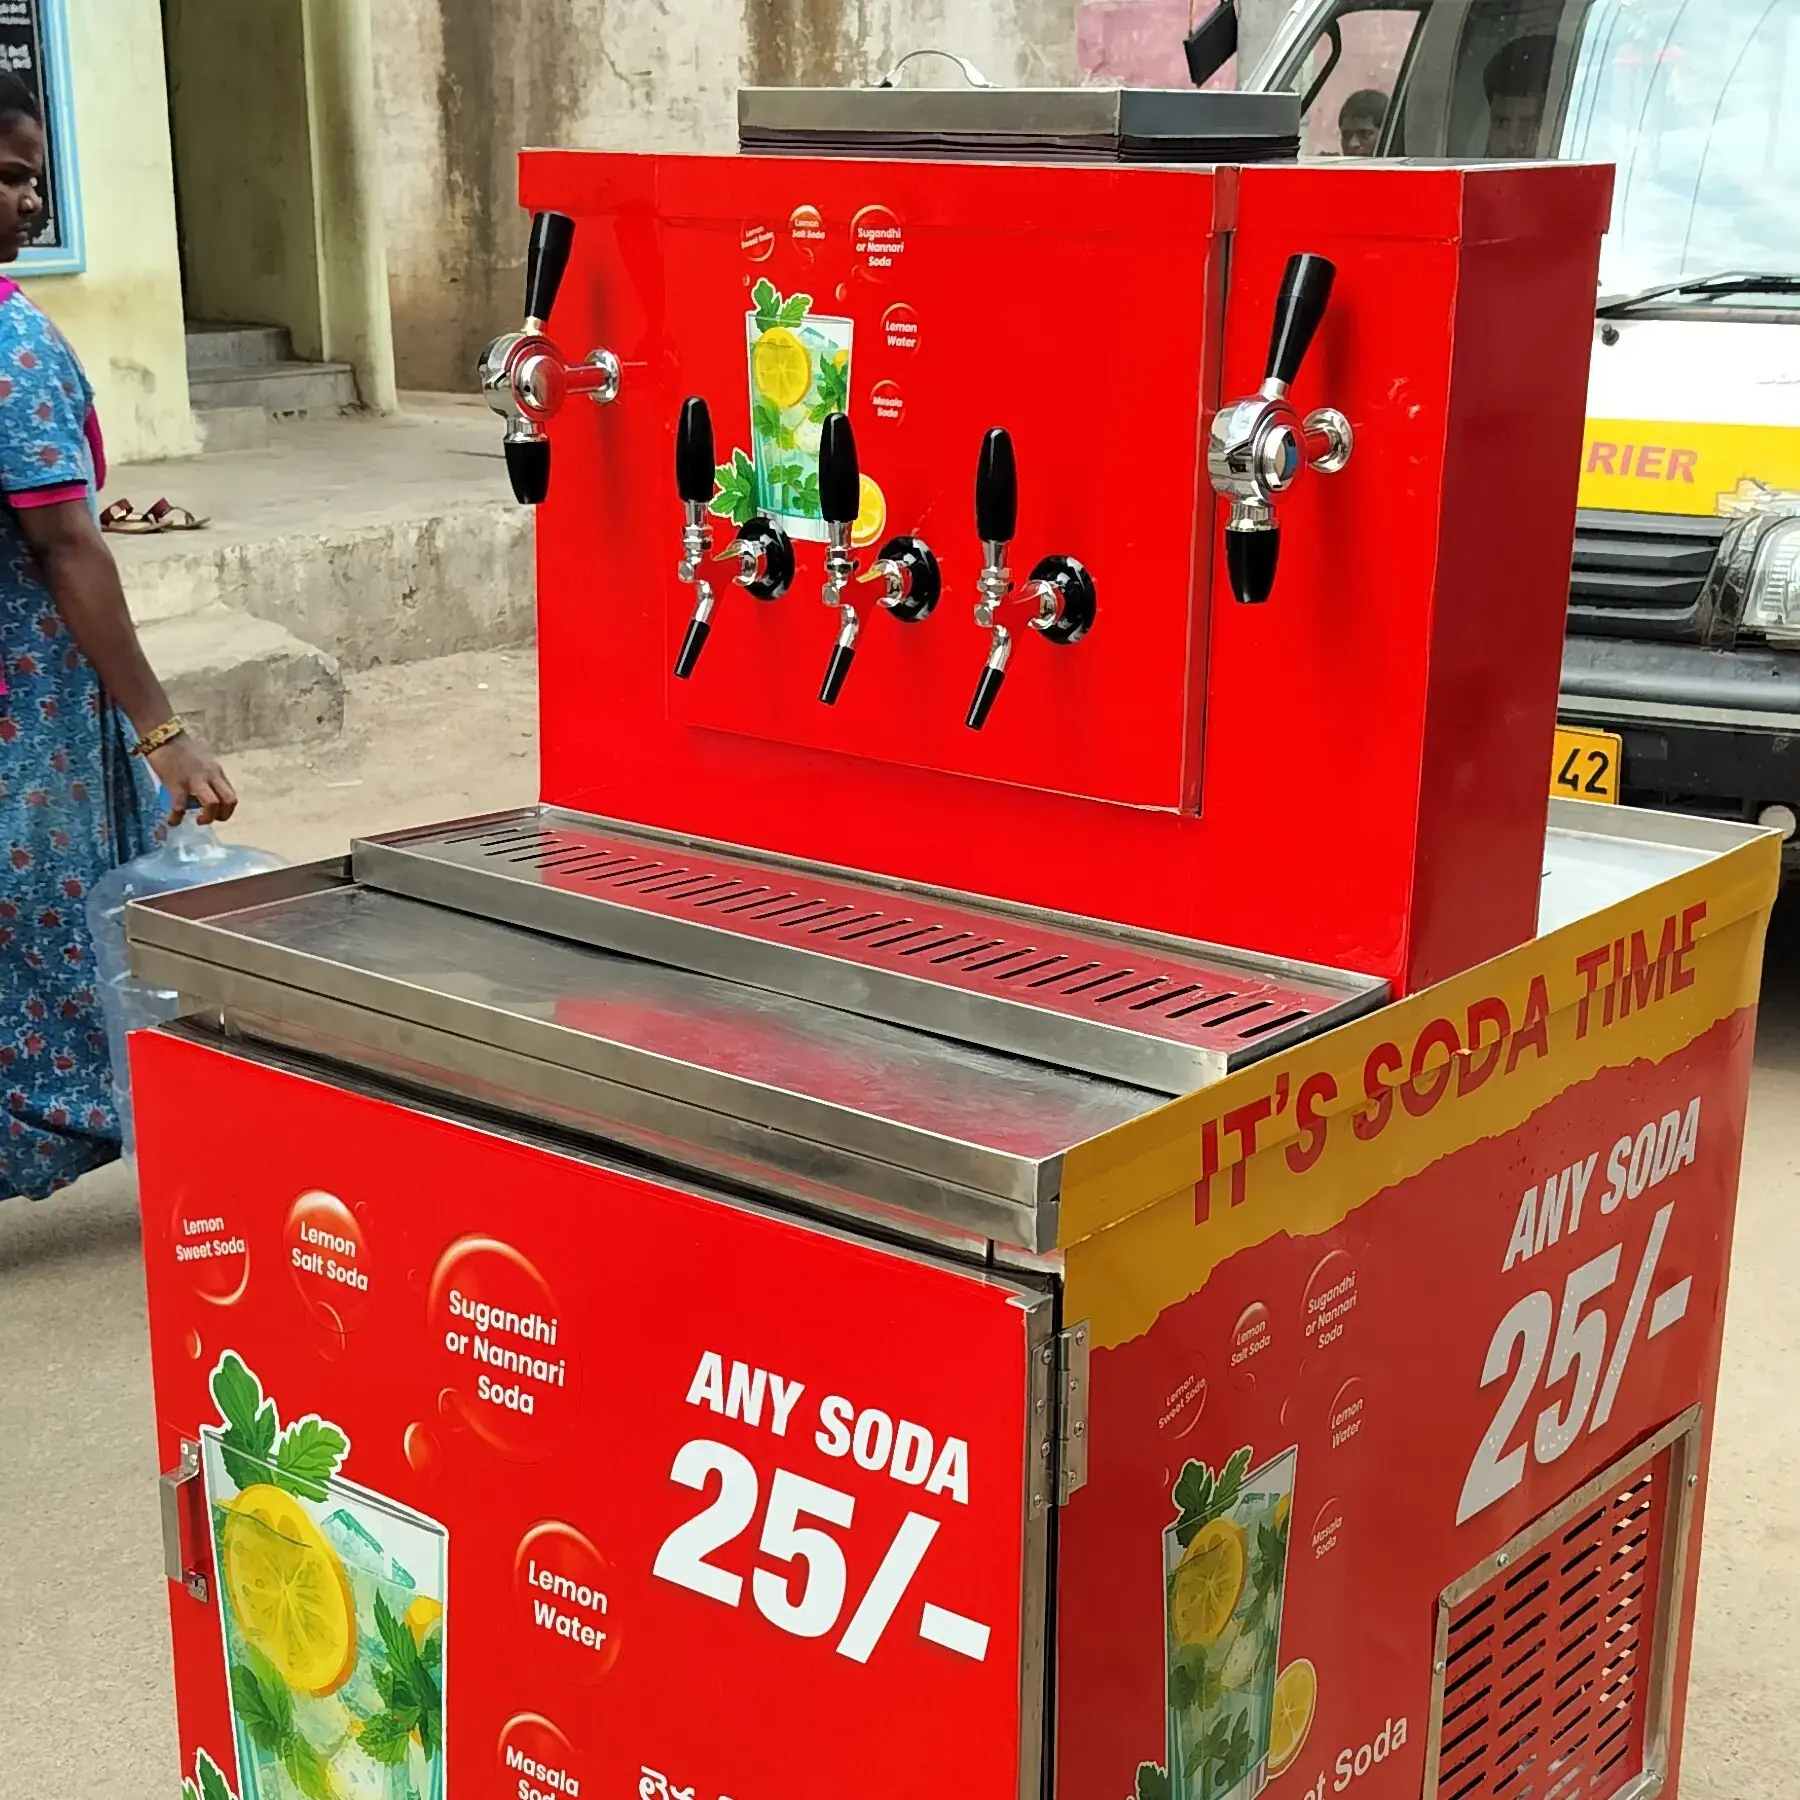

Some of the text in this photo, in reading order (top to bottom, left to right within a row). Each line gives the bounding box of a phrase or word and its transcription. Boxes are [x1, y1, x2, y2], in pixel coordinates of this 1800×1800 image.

[856, 242, 905, 253] or Nannari
[858, 228, 902, 241] Sugandhi
[868, 256, 892, 267] Soda
[886, 321, 918, 333] Lemon
[887, 335, 917, 347] Water
[877, 408, 899, 418] Soda
[1352, 974, 1550, 1141] SODA
[1575, 900, 1707, 1040] TIME
[1502, 1097, 1700, 1273] ANY SODA
[183, 1217, 225, 1236] Lemon
[300, 1221, 356, 1258] Lemon
[175, 1236, 246, 1262] Sweet Soda
[291, 1248, 369, 1292] Salt Soda
[1308, 1270, 1356, 1314] Sugandhi
[449, 1289, 558, 1346] Sugandhi
[1305, 1290, 1358, 1337] or Nannari
[1230, 1334, 1271, 1367] Salt Soda
[1236, 1320, 1266, 1346] Lemon
[1318, 1323, 1344, 1349] Soda
[445, 1331, 566, 1387] or Nannari
[1455, 1201, 1693, 1526] 25/-
[477, 1374, 535, 1416] Soda
[1158, 1377, 1205, 1429] Sweet Soda
[1166, 1374, 1194, 1407] Lemon
[685, 1350, 970, 1505] ANY SODA
[1331, 1398, 1364, 1430] Lemon
[1332, 1419, 1362, 1449] Water
[1311, 1516, 1342, 1547] Masala
[1315, 1535, 1337, 1560] Soda
[652, 1439, 992, 1665] 25/-
[528, 1559, 608, 1615] Lemon
[533, 1599, 607, 1651] Water
[505, 1745, 579, 1798] Masala
[1333, 1717, 1408, 1792] Soda
